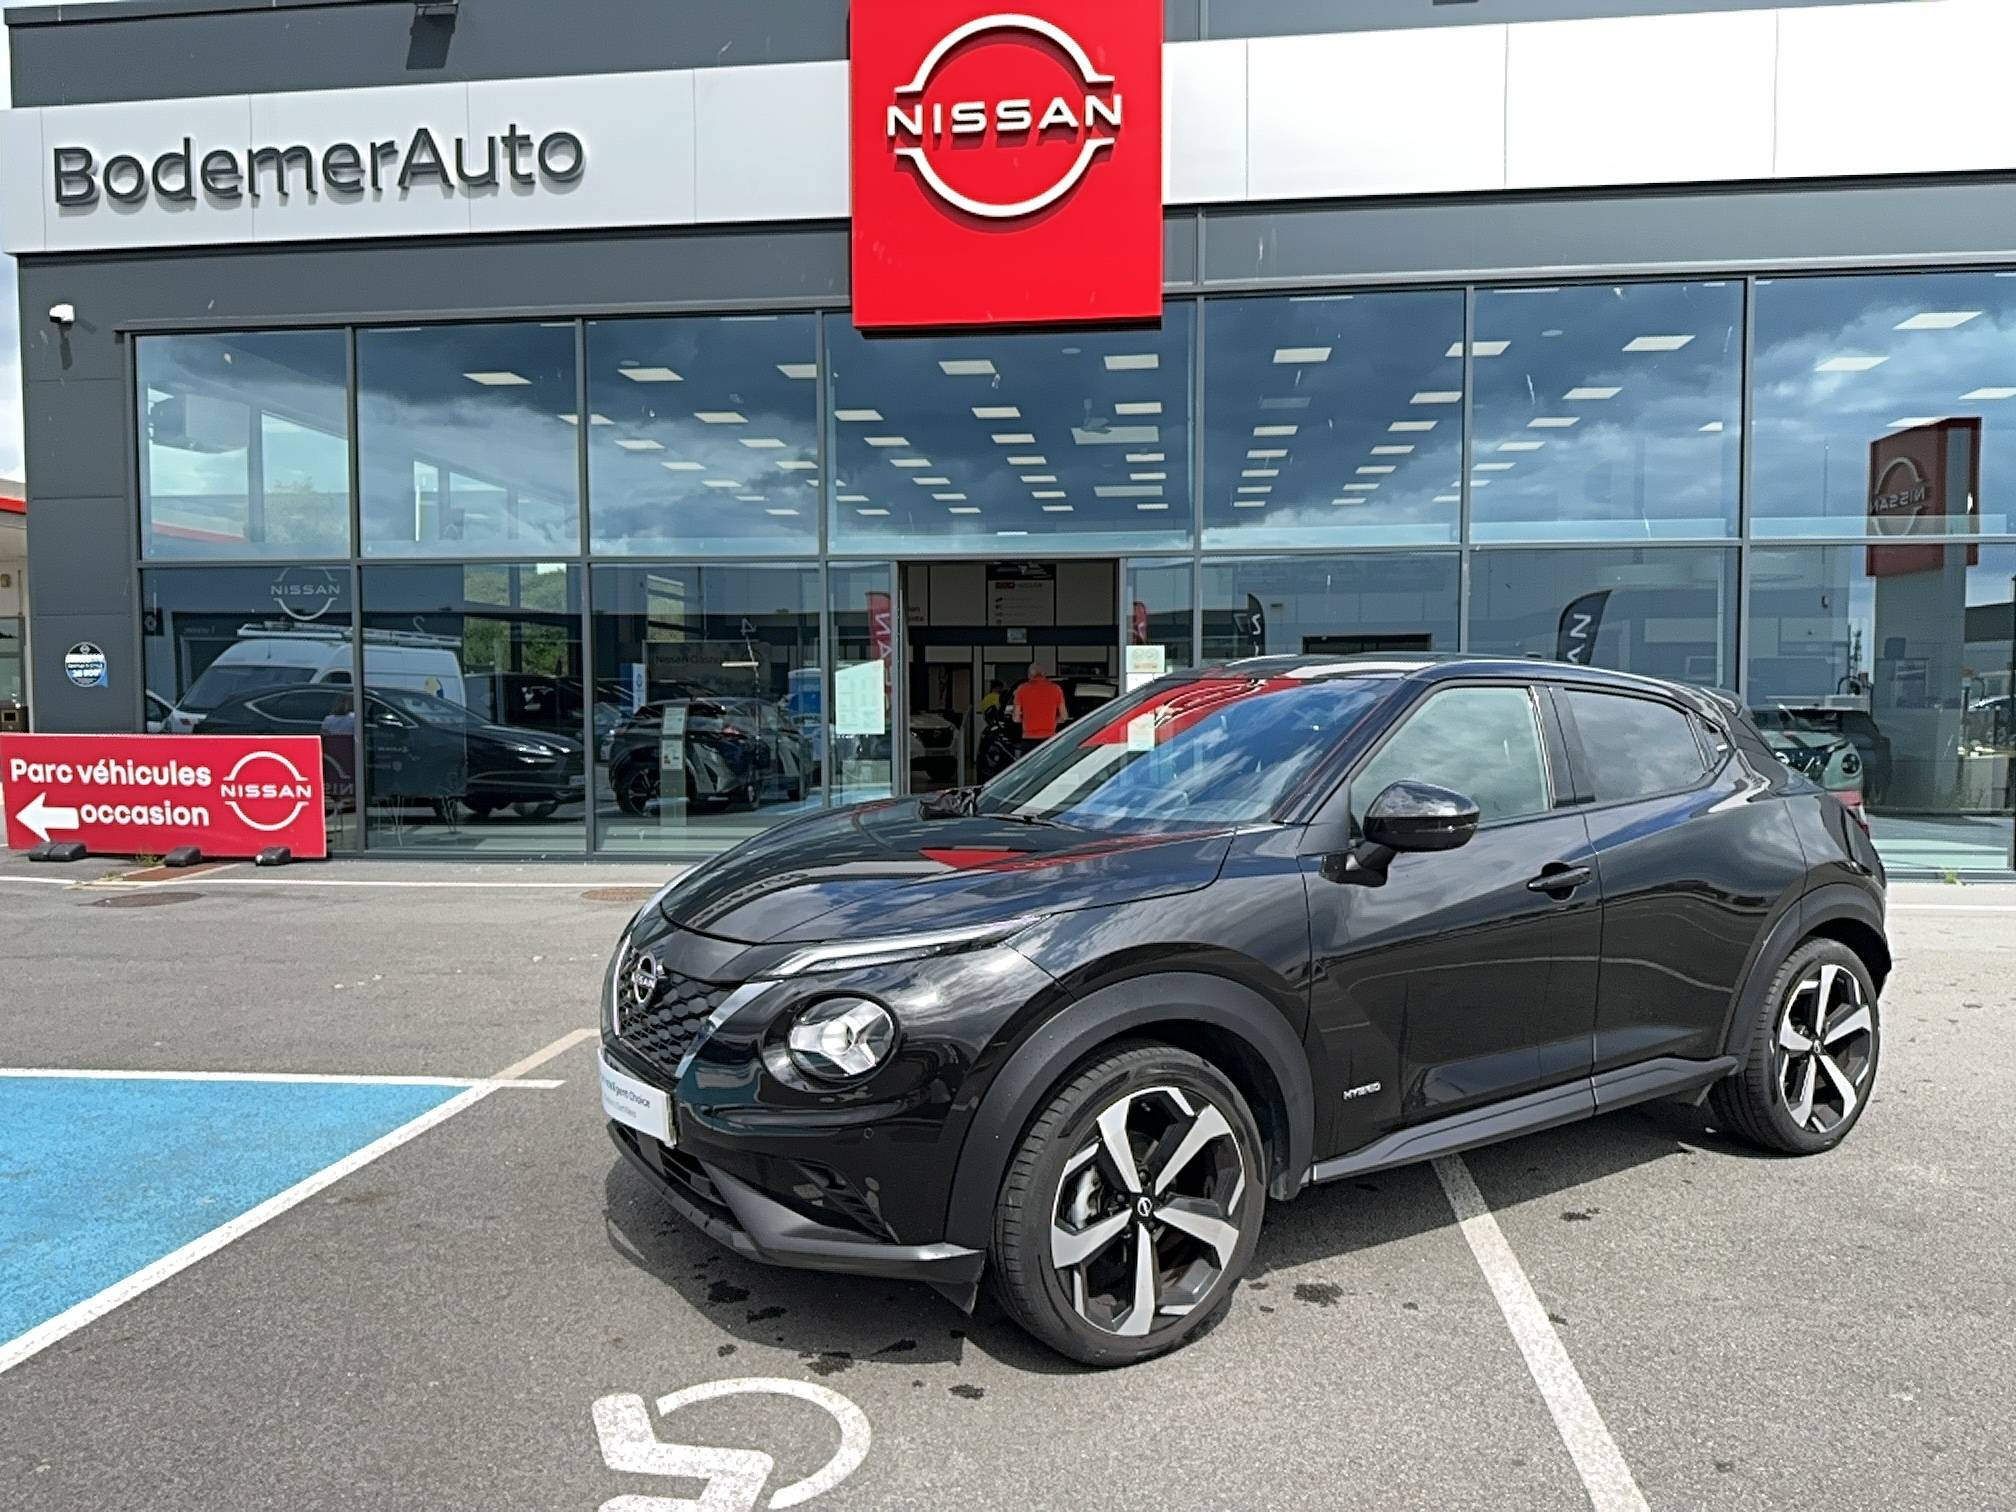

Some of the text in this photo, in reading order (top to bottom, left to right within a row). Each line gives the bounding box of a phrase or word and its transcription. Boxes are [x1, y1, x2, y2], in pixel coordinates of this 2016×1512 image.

[886, 94, 1123, 138] NISSAN
[53, 123, 584, 207] BodemerAuto
[270, 584, 341, 595] NISSAN
[10, 758, 212, 787] Parc véhicules
[220, 783, 312, 799] NISSAN
[80, 799, 210, 827] occasion
